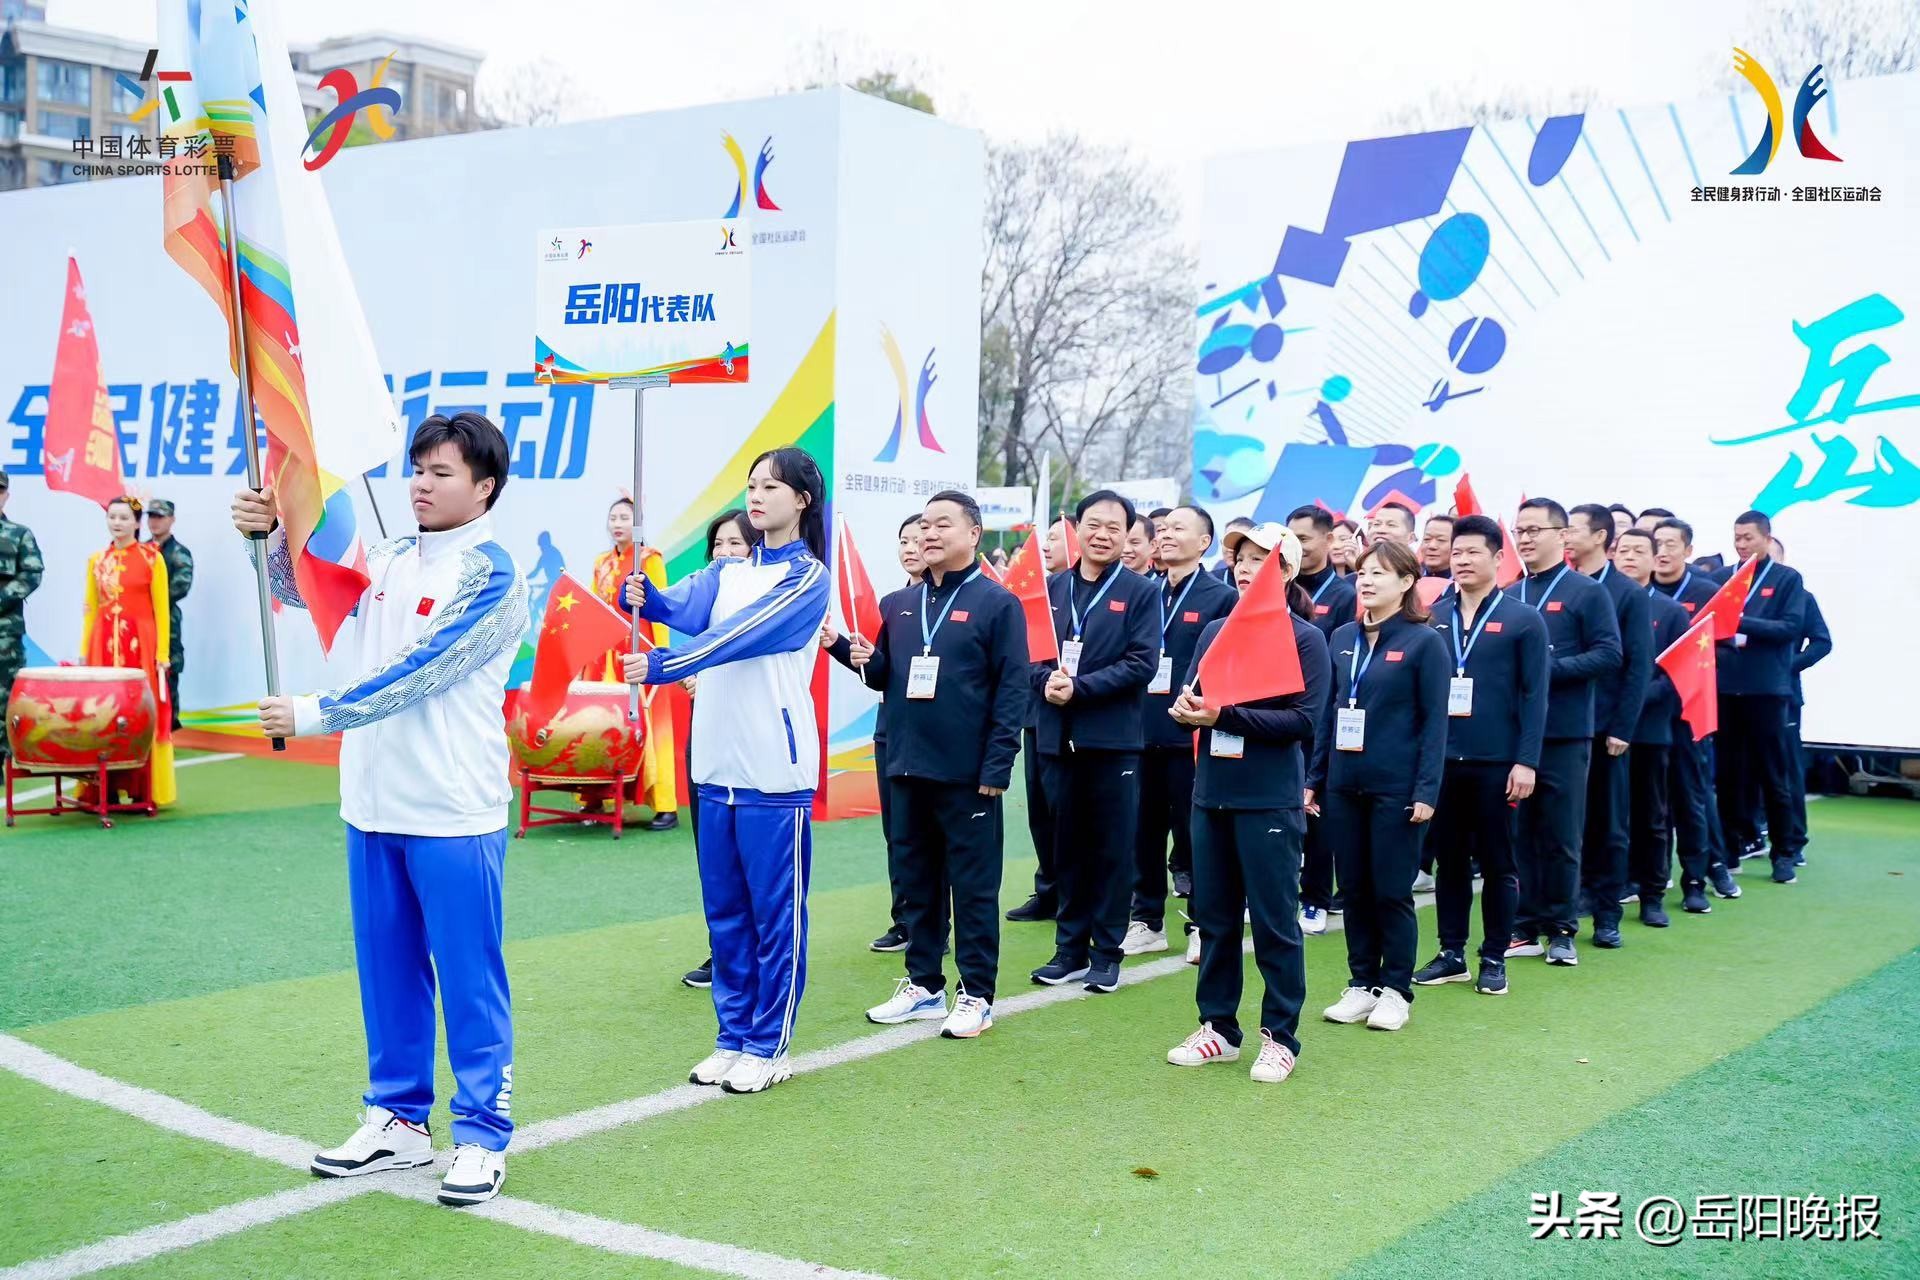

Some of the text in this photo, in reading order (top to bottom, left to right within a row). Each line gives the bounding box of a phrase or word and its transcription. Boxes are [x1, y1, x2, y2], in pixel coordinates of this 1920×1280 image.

[564, 283, 716, 325] 岳阳代表队
[3, 371, 595, 479] 全民健身行动
